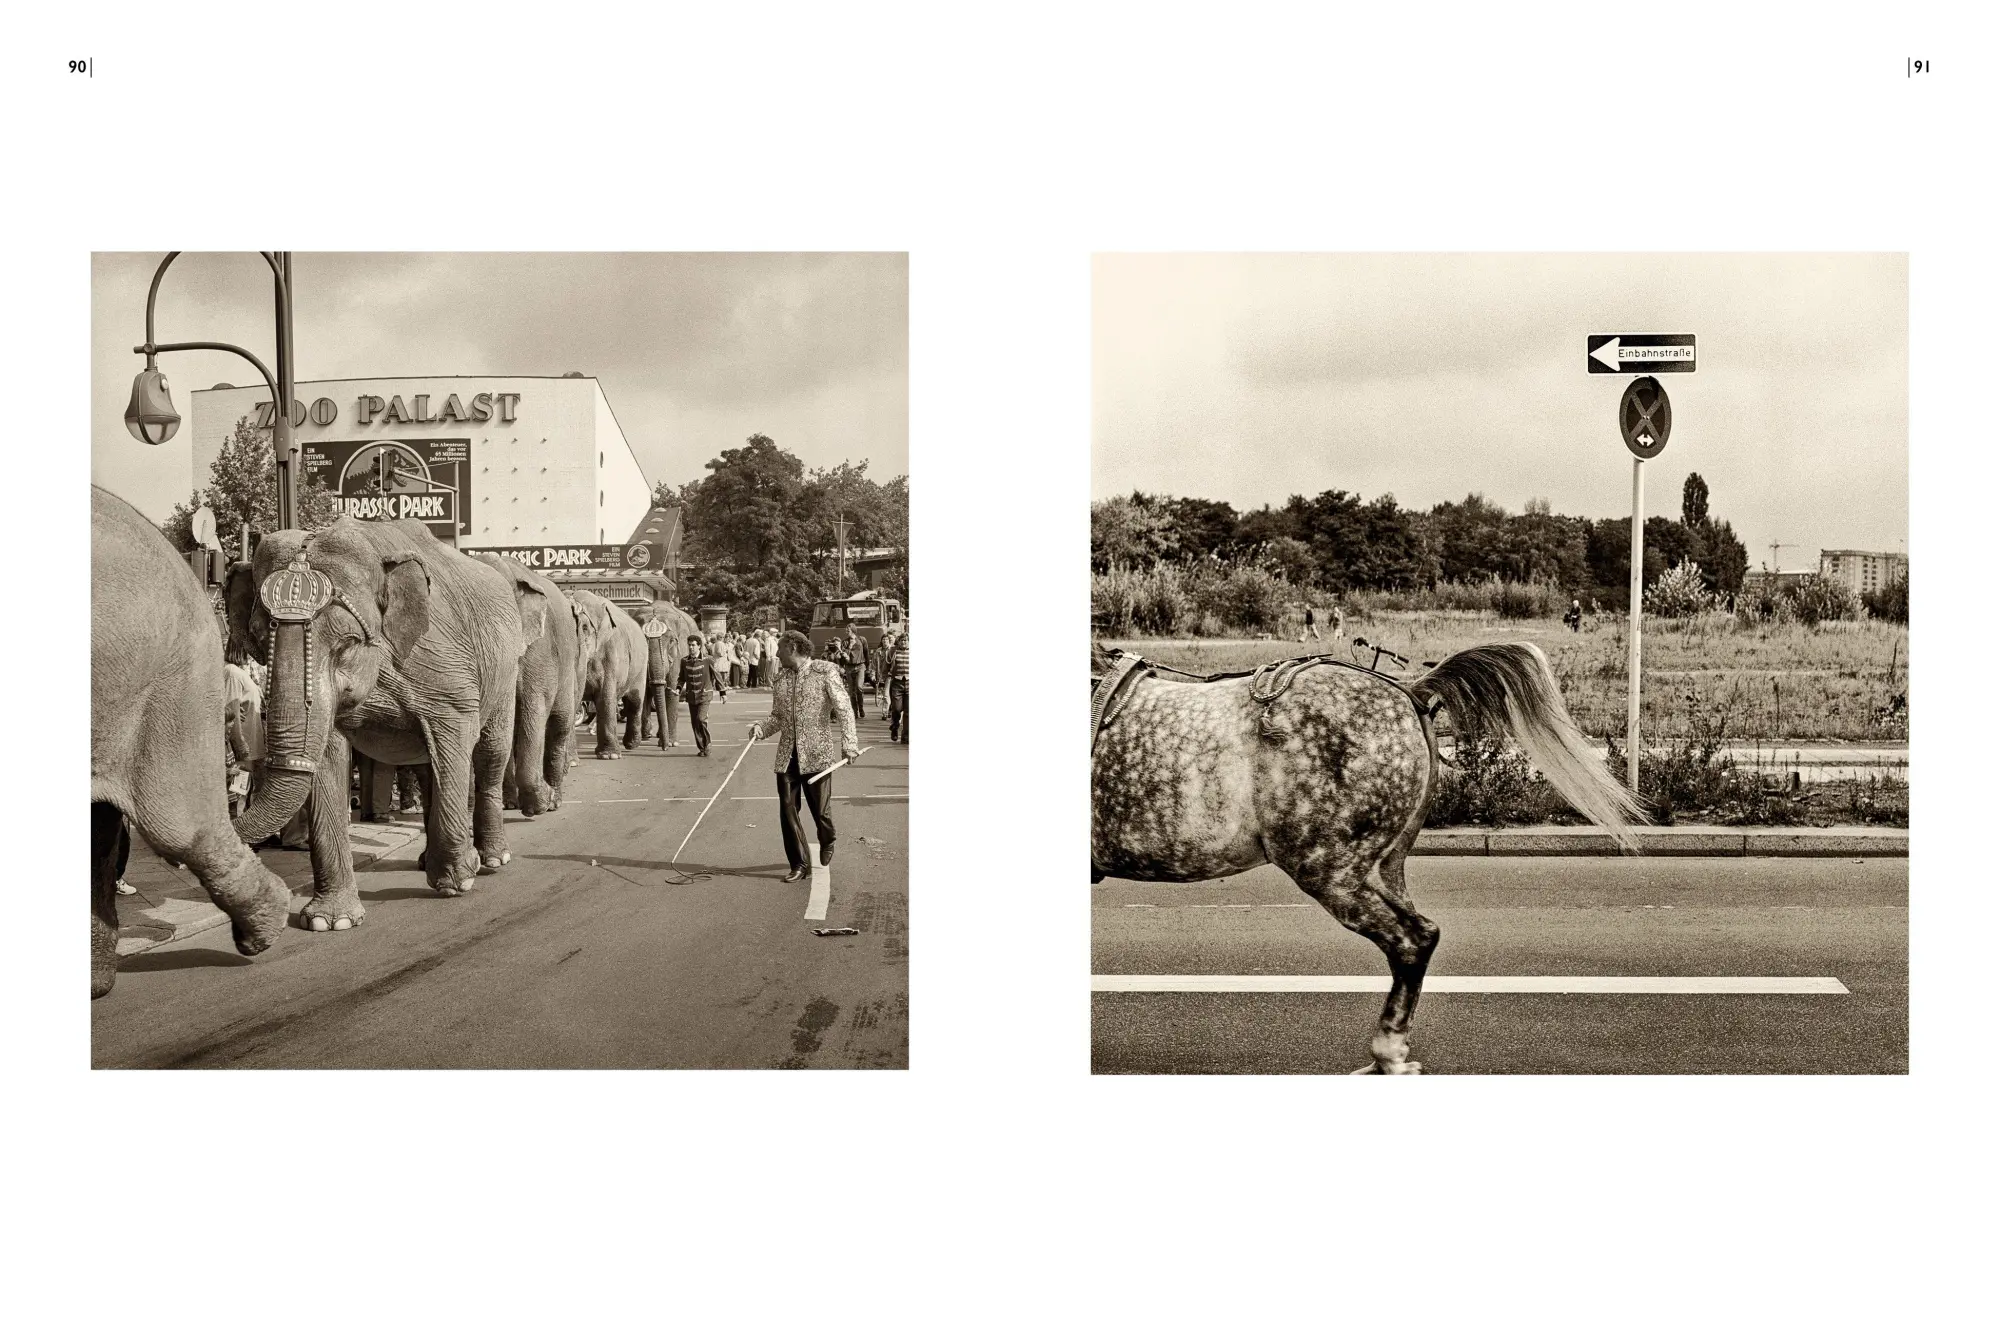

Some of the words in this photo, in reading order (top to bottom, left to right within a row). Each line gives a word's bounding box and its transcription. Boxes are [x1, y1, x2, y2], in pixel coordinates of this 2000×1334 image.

[1618, 348, 1691, 358] Einbahnstraße
[357, 393, 521, 424] PALAST
[400, 495, 445, 519] PARK
[543, 548, 593, 568] PARK
